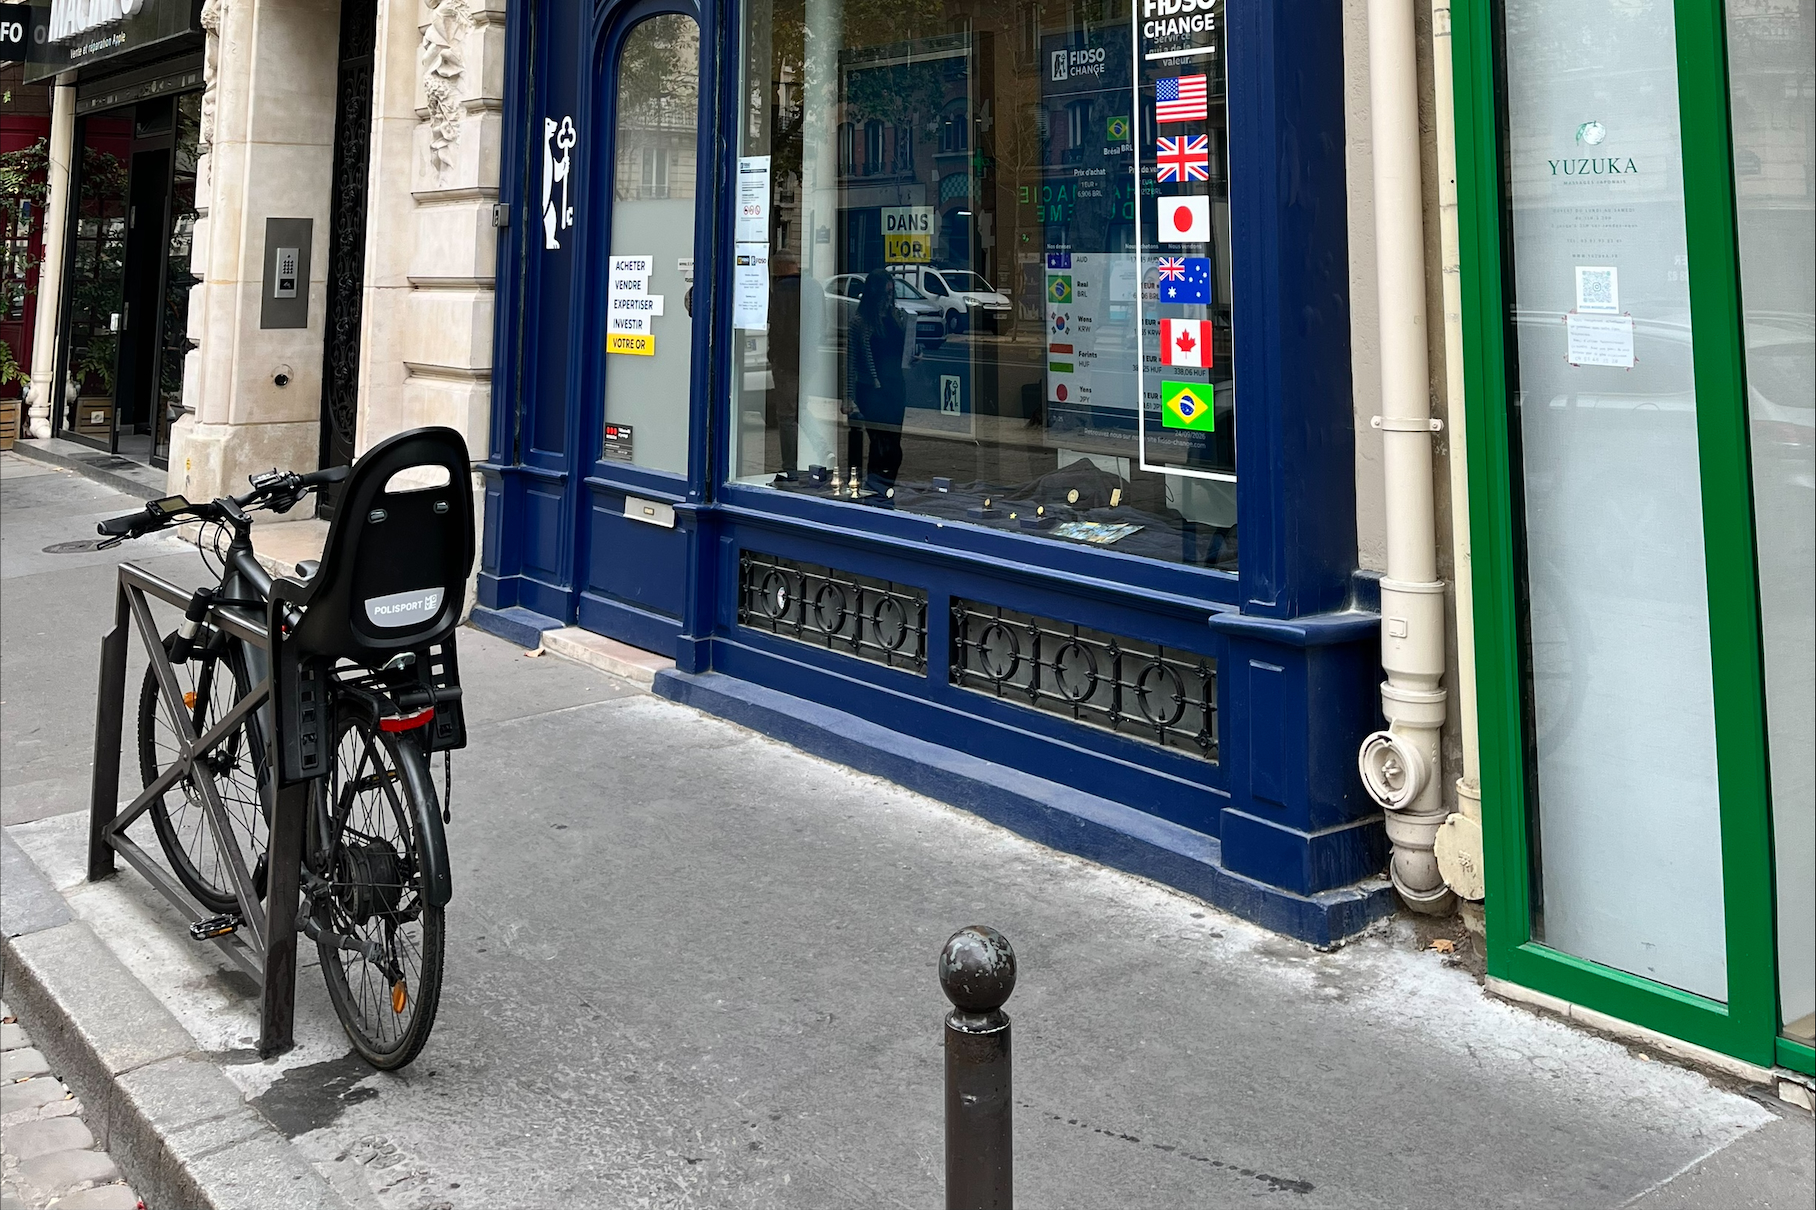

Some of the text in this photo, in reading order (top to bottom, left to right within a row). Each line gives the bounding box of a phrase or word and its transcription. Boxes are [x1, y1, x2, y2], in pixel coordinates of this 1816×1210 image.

[1143, 12, 1215, 39] CHANGE
[112, 30, 126, 47] Apple
[1154, 32, 1191, 44] Servir ce
[1070, 47, 1106, 65] FIDSO
[1163, 56, 1192, 66] valeur.
[1070, 63, 1105, 77] CHANGE
[1103, 143, 1133, 156] Brésil BRL
[1074, 167, 1106, 177] Prix d'achat
[1547, 157, 1638, 176] YUZUKA
[886, 213, 929, 231] DANS
[889, 240, 927, 259] L'OR.
[615, 260, 646, 271] ACHETER
[615, 279, 641, 290] VENDRE
[1076, 280, 1089, 288] Real
[1076, 290, 1087, 298] BRL
[613, 299, 654, 310] EXPERTISER
[613, 318, 643, 329] INVESTIR
[1078, 315, 1092, 323] Wons
[1078, 325, 1091, 333] KRW
[612, 337, 646, 349] VOTRE OR
[1078, 351, 1097, 359] Forints
[1146, 355, 1157, 363] EUR
[1150, 365, 1162, 373] HUF
[1174, 368, 1206, 377] 338,06 HUF
[1147, 392, 1158, 400] EUR
[374, 600, 423, 616] POLISPORT
